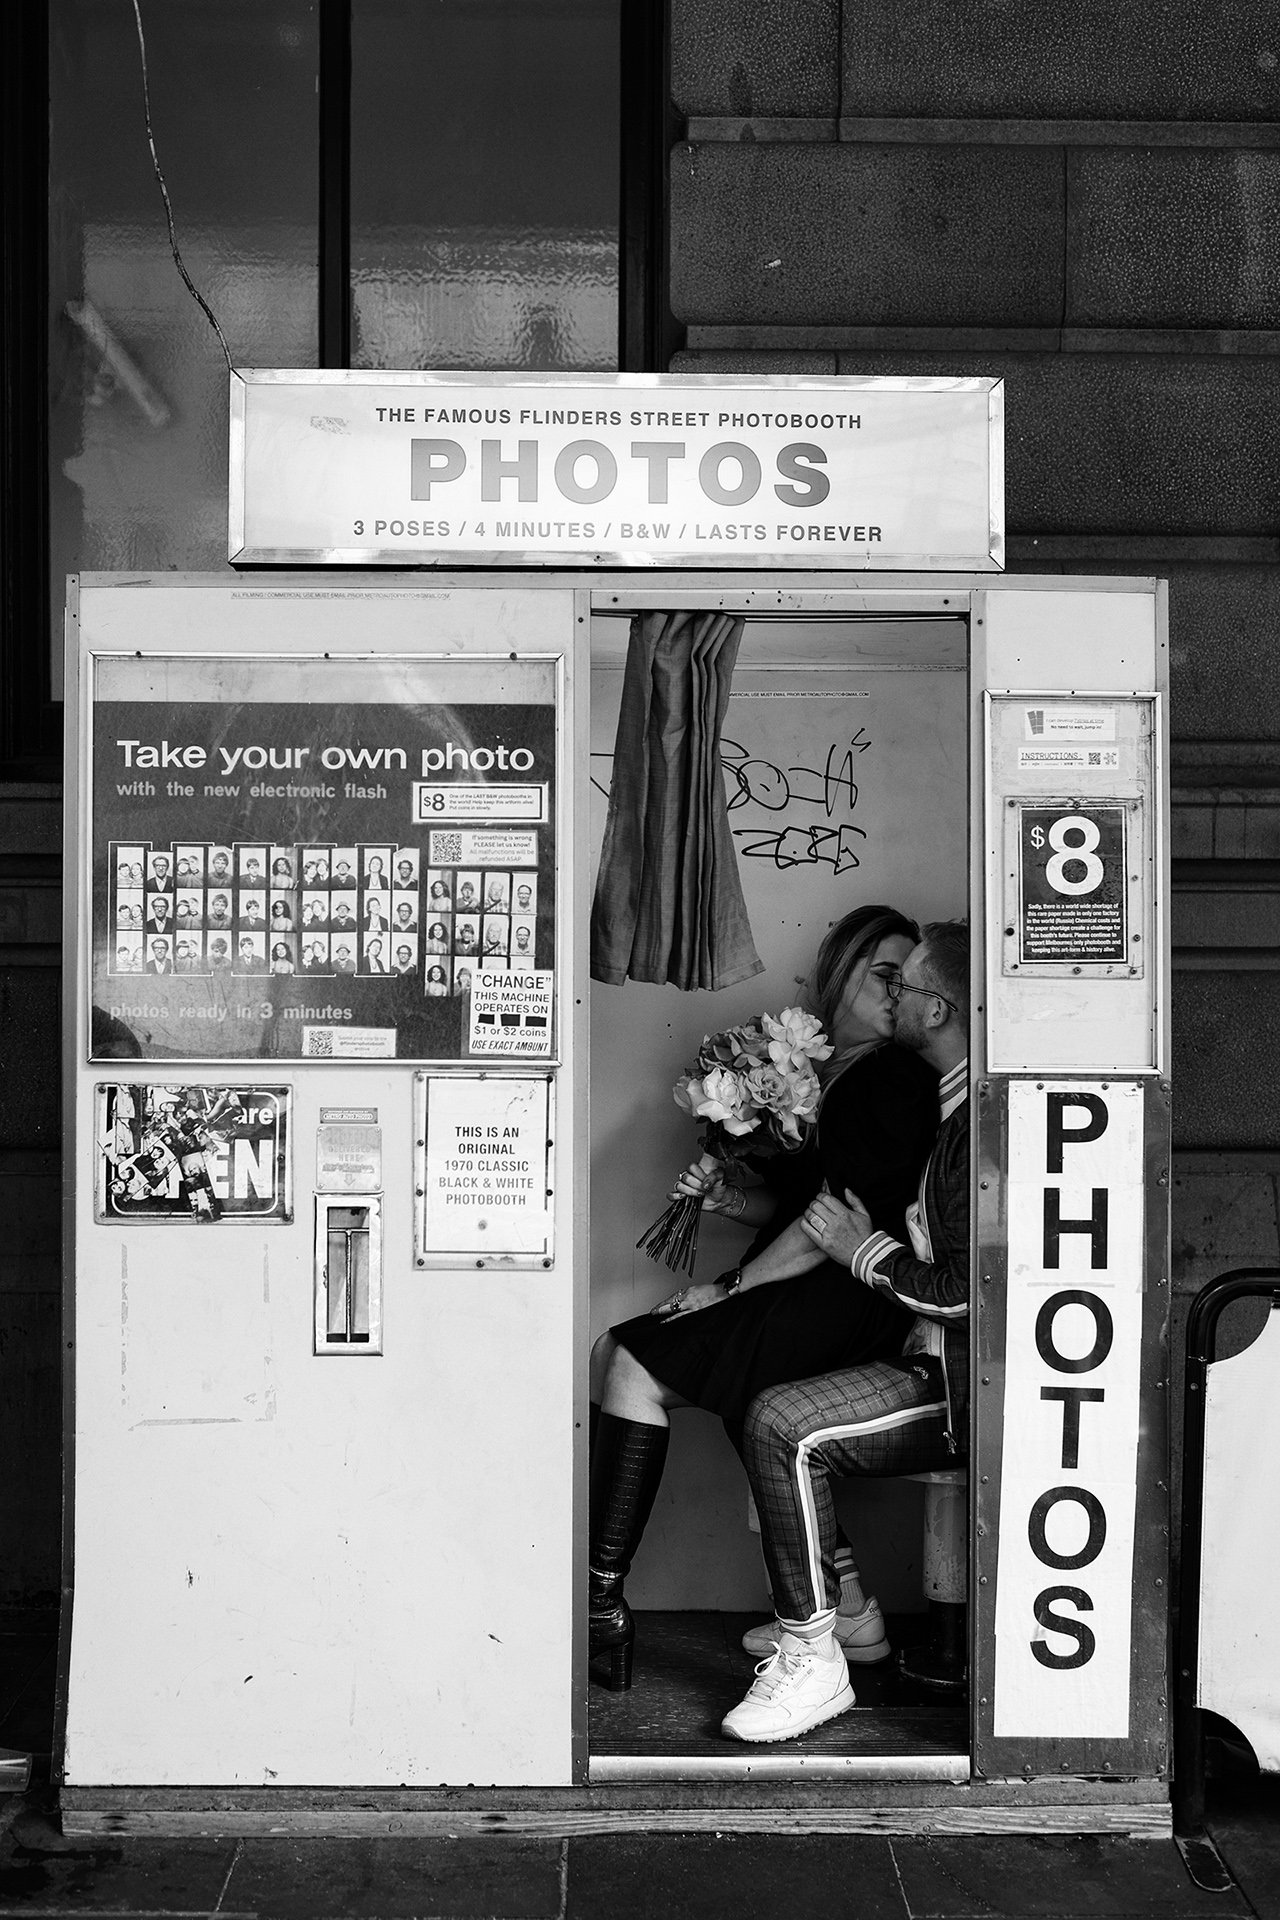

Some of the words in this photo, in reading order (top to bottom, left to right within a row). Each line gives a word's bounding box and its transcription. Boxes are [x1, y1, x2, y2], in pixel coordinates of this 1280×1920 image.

[375, 408, 416, 422] THE
[424, 408, 511, 424] FAMOUS
[519, 410, 622, 426] FLINDERS
[630, 411, 710, 427] STREET
[718, 412, 862, 429] PHOTOBOOTH
[410, 438, 831, 508] PHOTOS
[353, 520, 365, 536] 3
[374, 520, 451, 536] POSES
[458, 521, 467, 537] /
[474, 521, 486, 537] 4
[495, 522, 597, 538] MINUTES
[603, 522, 612, 539] /
[620, 523, 671, 539] B&W
[678, 524, 688, 540] /
[695, 524, 767, 540] LASTS
[776, 525, 882, 542] FOREVER
[116, 740, 207, 768] Take
[219, 747, 310, 775] your
[321, 747, 407, 770] own
[421, 742, 535, 777] photo
[116, 781, 155, 796] with
[166, 781, 195, 796] the
[204, 784, 240, 797] new
[250, 783, 336, 798] electronic
[344, 783, 387, 799] flash
[424, 793, 445, 811] $8
[1031, 816, 1104, 895] $8
[476, 974, 551, 989] "CHANGE"
[474, 991, 498, 1001] THIS
[501, 993, 550, 1002] MACHINE
[110, 1003, 169, 1020] photos
[178, 1004, 228, 1022] ready
[236, 1004, 251, 1019] in
[260, 1003, 274, 1019] 3
[283, 1004, 353, 1020] minutes
[474, 1003, 530, 1013] OPERATES
[532, 1005, 548, 1014] ON
[474, 1025, 486, 1035] $1
[503, 1027, 517, 1036] $2
[519, 1028, 547, 1037] coins
[471, 1040, 487, 1049] USE
[488, 1040, 514, 1050] EXACT
[455, 1126, 482, 1137] THIS
[486, 1127, 498, 1137] IS
[502, 1127, 519, 1137] AN
[458, 1143, 515, 1154] ORIGINAL
[444, 1160, 473, 1171] 1970
[477, 1160, 529, 1172] CLASSIC
[439, 1176, 478, 1188] BLACK
[482, 1177, 491, 1188] &
[495, 1178, 533, 1189] WHITE
[446, 1194, 526, 1205] PHOTOBOOTH
[1028, 1091, 1114, 1670] PHOTOS
